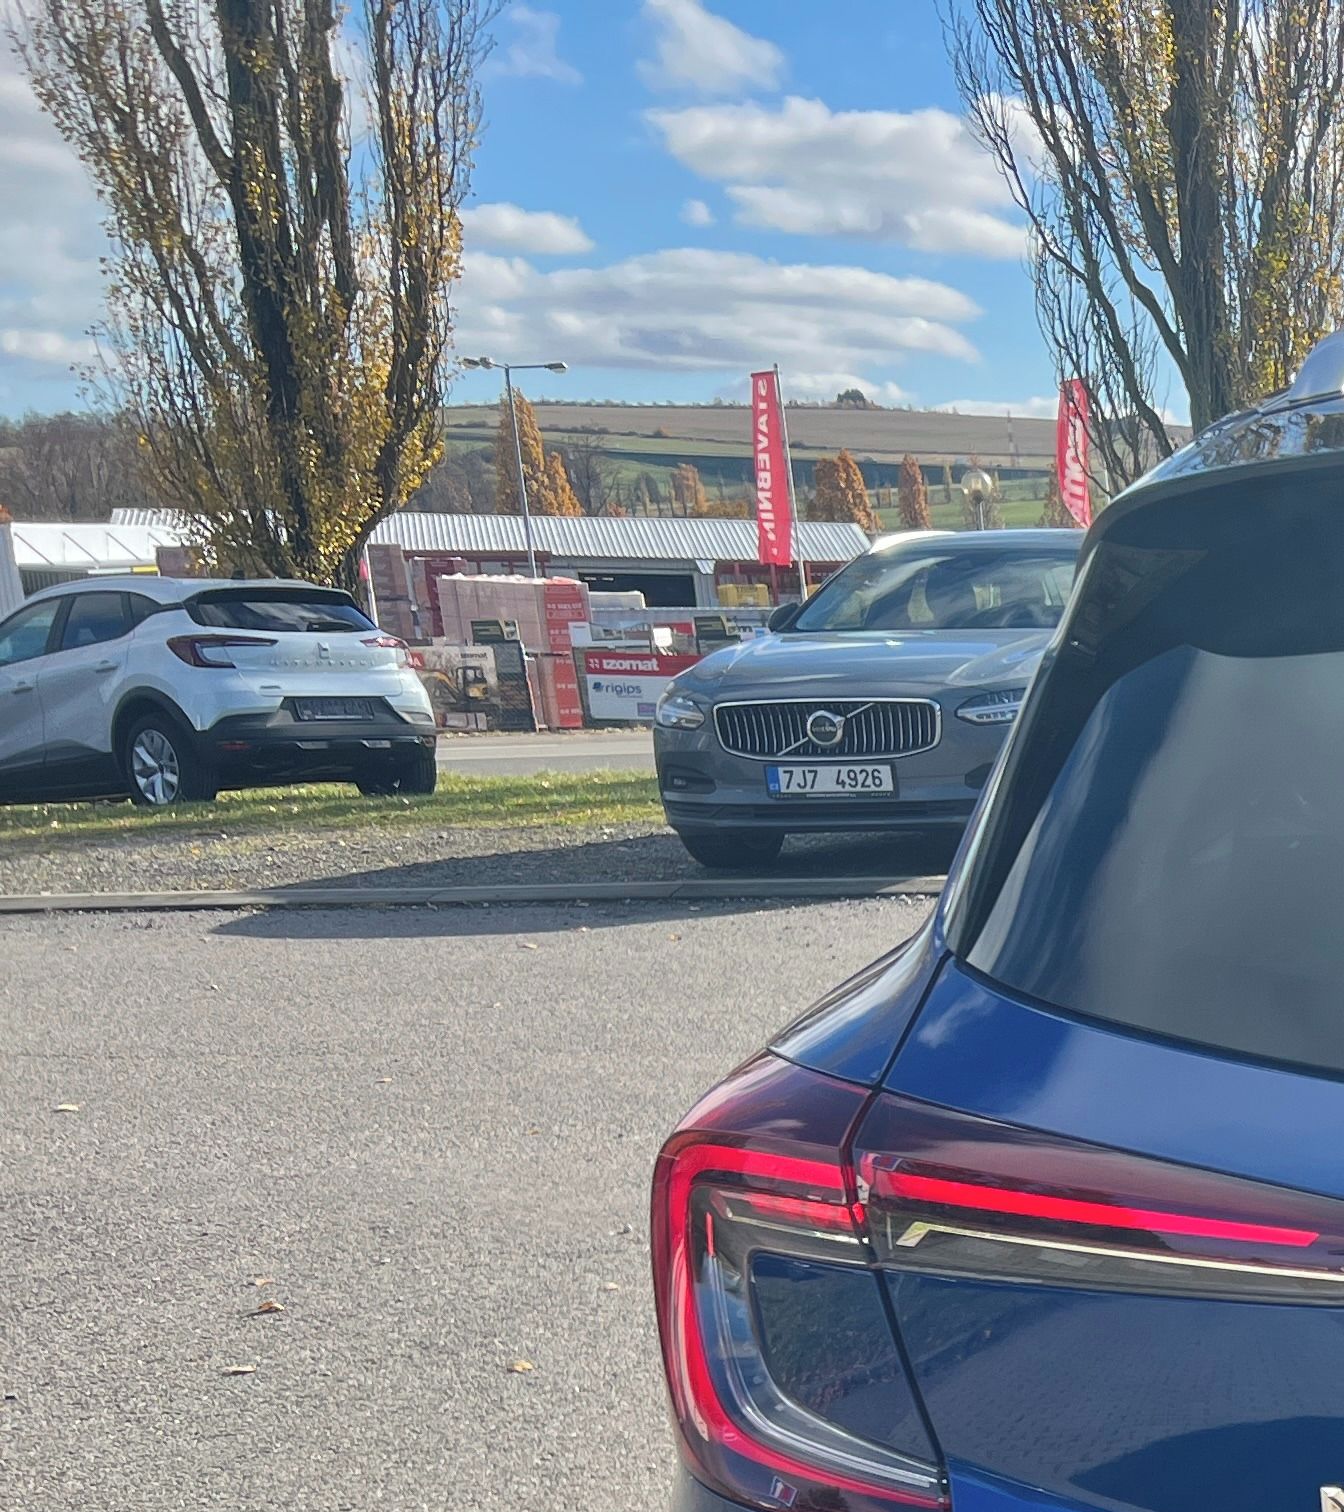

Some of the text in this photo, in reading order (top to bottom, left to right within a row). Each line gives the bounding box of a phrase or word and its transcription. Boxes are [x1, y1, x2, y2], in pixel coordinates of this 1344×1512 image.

[602, 658, 660, 671] izomat
[605, 682, 642, 695] rigips
[782, 768, 884, 790] 7J7 4926
